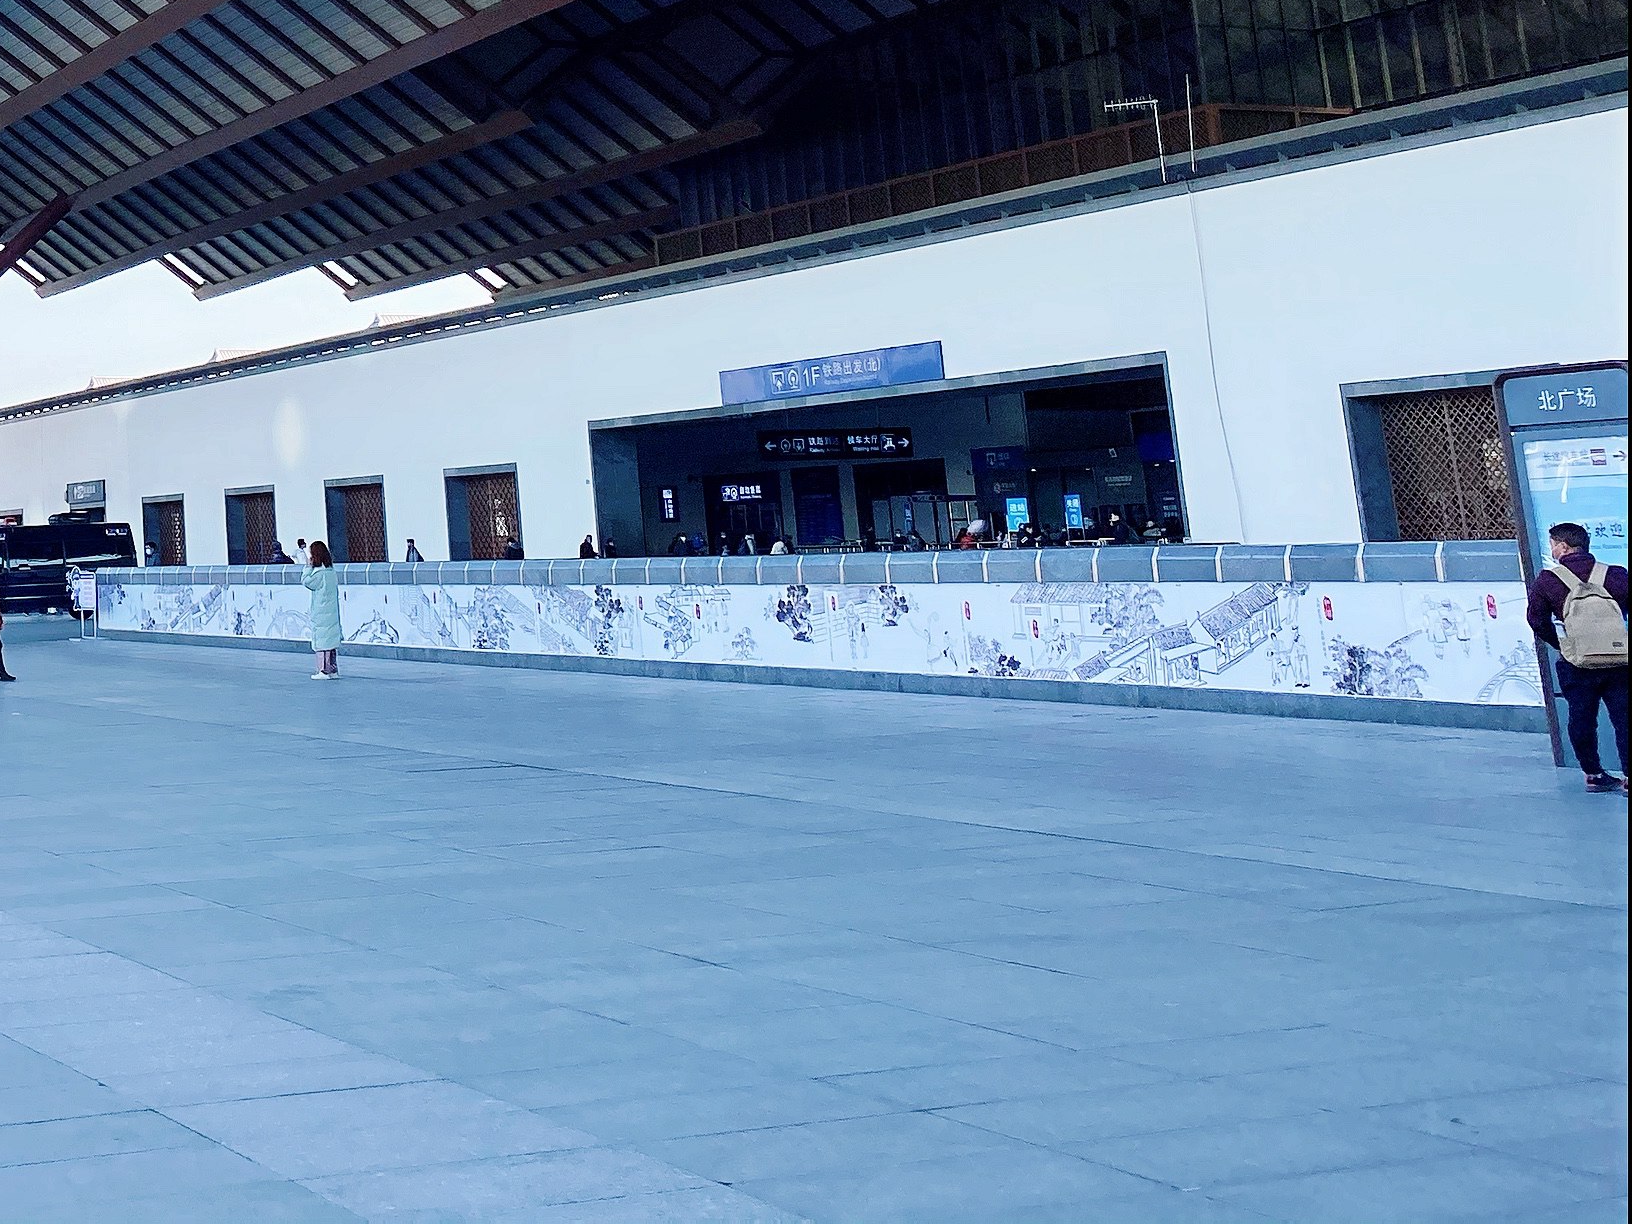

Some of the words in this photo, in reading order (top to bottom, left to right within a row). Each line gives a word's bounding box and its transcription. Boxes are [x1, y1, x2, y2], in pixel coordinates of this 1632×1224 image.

[802, 366, 821, 388] 1F
[1537, 386, 1597, 412] 北广场
